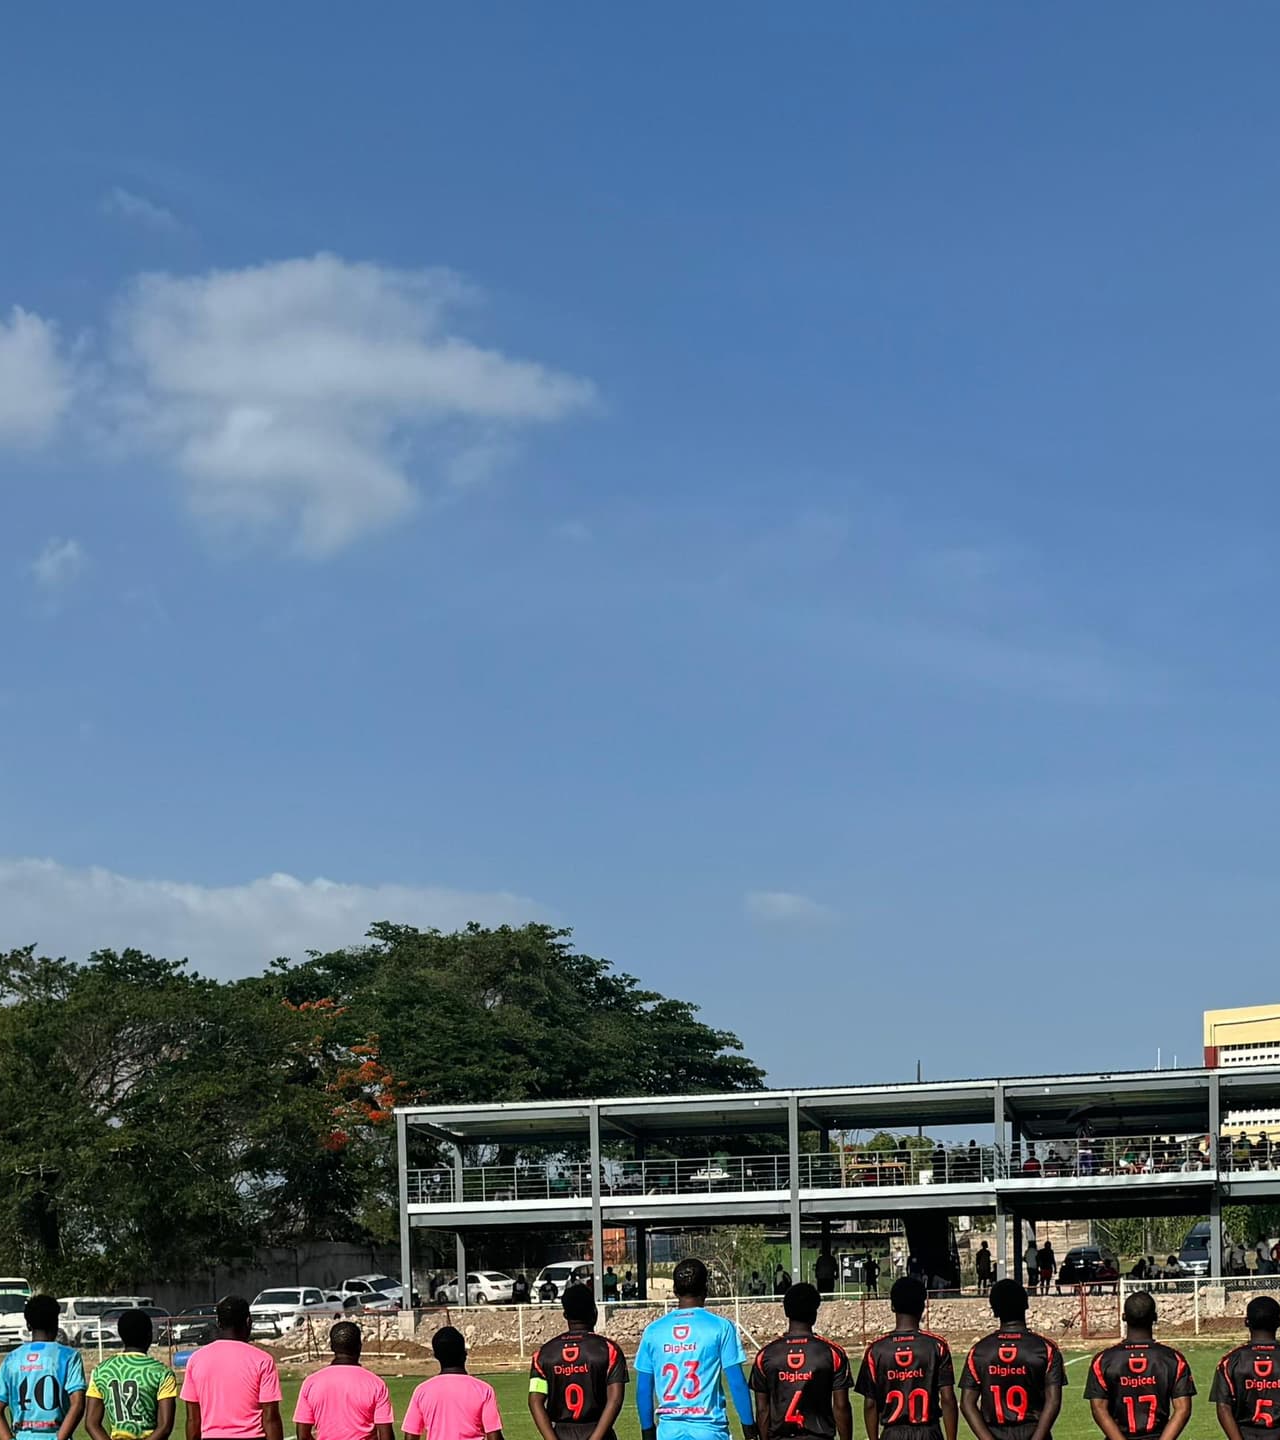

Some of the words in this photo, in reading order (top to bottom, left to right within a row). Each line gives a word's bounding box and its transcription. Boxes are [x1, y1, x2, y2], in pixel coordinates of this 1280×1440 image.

[663, 1342, 697, 1355] Digicel
[553, 1363, 588, 1376] Digicel
[662, 1360, 700, 1401] 23
[778, 1371, 813, 1382] Digicel
[887, 1368, 924, 1382] Digicel
[988, 1364, 1027, 1377] Digicel
[1120, 1375, 1157, 1388] Digicel
[19, 1374, 61, 1411] 40
[108, 1379, 144, 1423] 12
[565, 1383, 584, 1420] 9
[784, 1390, 805, 1428] 4
[885, 1388, 930, 1424] 20
[990, 1384, 1028, 1424] 19
[1123, 1394, 1158, 1433] 17
[1252, 1399, 1273, 1428] 5
